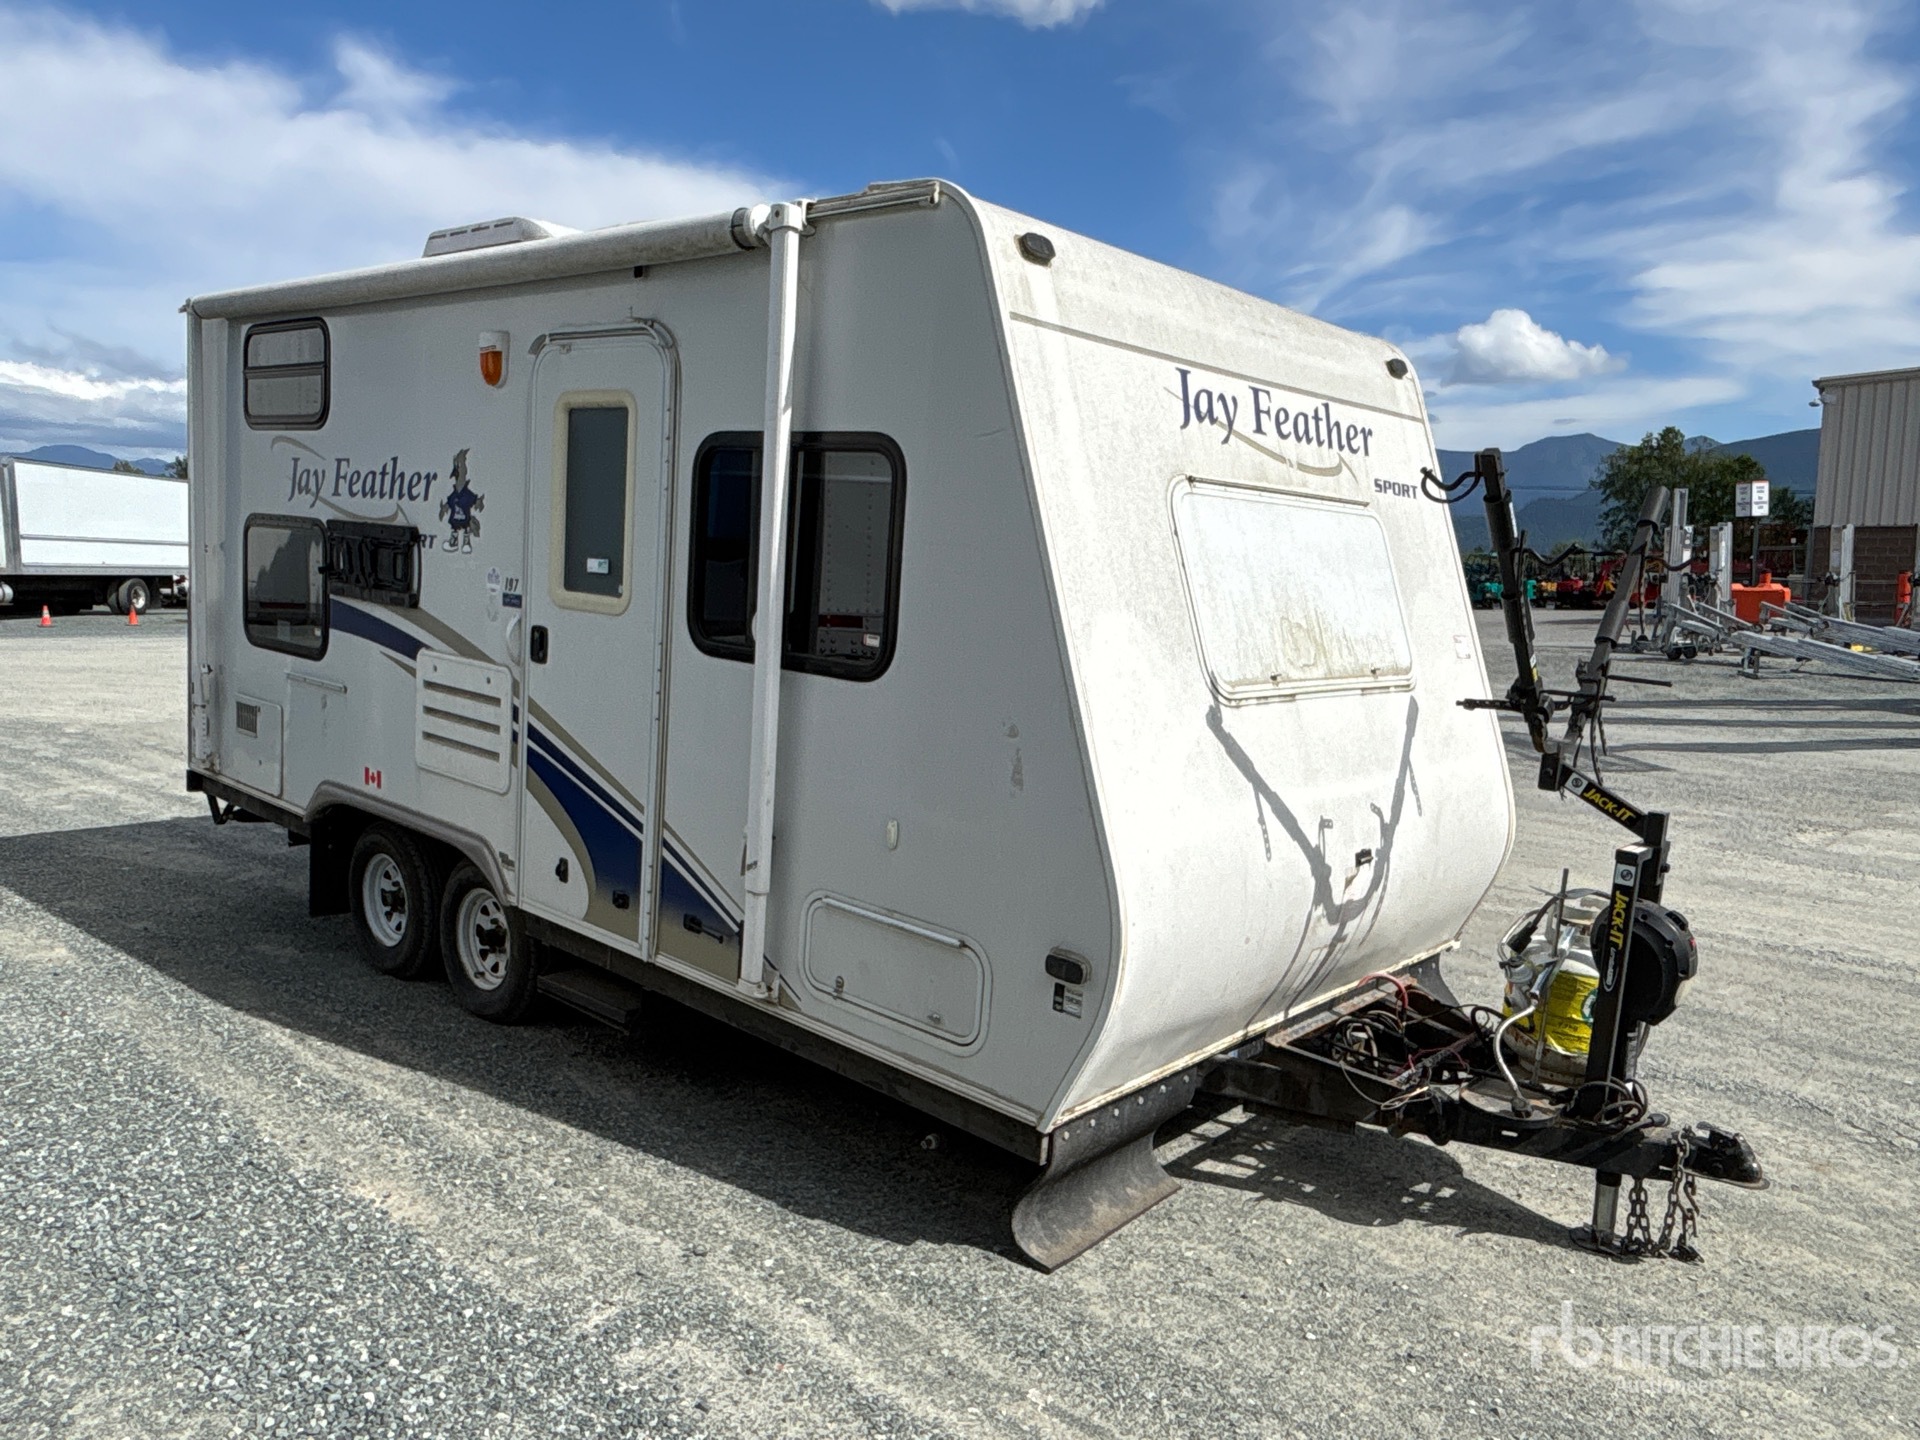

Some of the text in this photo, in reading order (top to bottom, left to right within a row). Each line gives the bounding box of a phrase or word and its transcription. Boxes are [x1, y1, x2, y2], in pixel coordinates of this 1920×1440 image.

[1175, 366, 1373, 457] Jay Feather
[288, 456, 438, 508] Jay Feather
[1374, 478, 1418, 499] SPORT
[505, 577, 519, 592] 197
[1583, 788, 1636, 821] JACK-IT
[1609, 890, 1629, 950] JACK-IT
